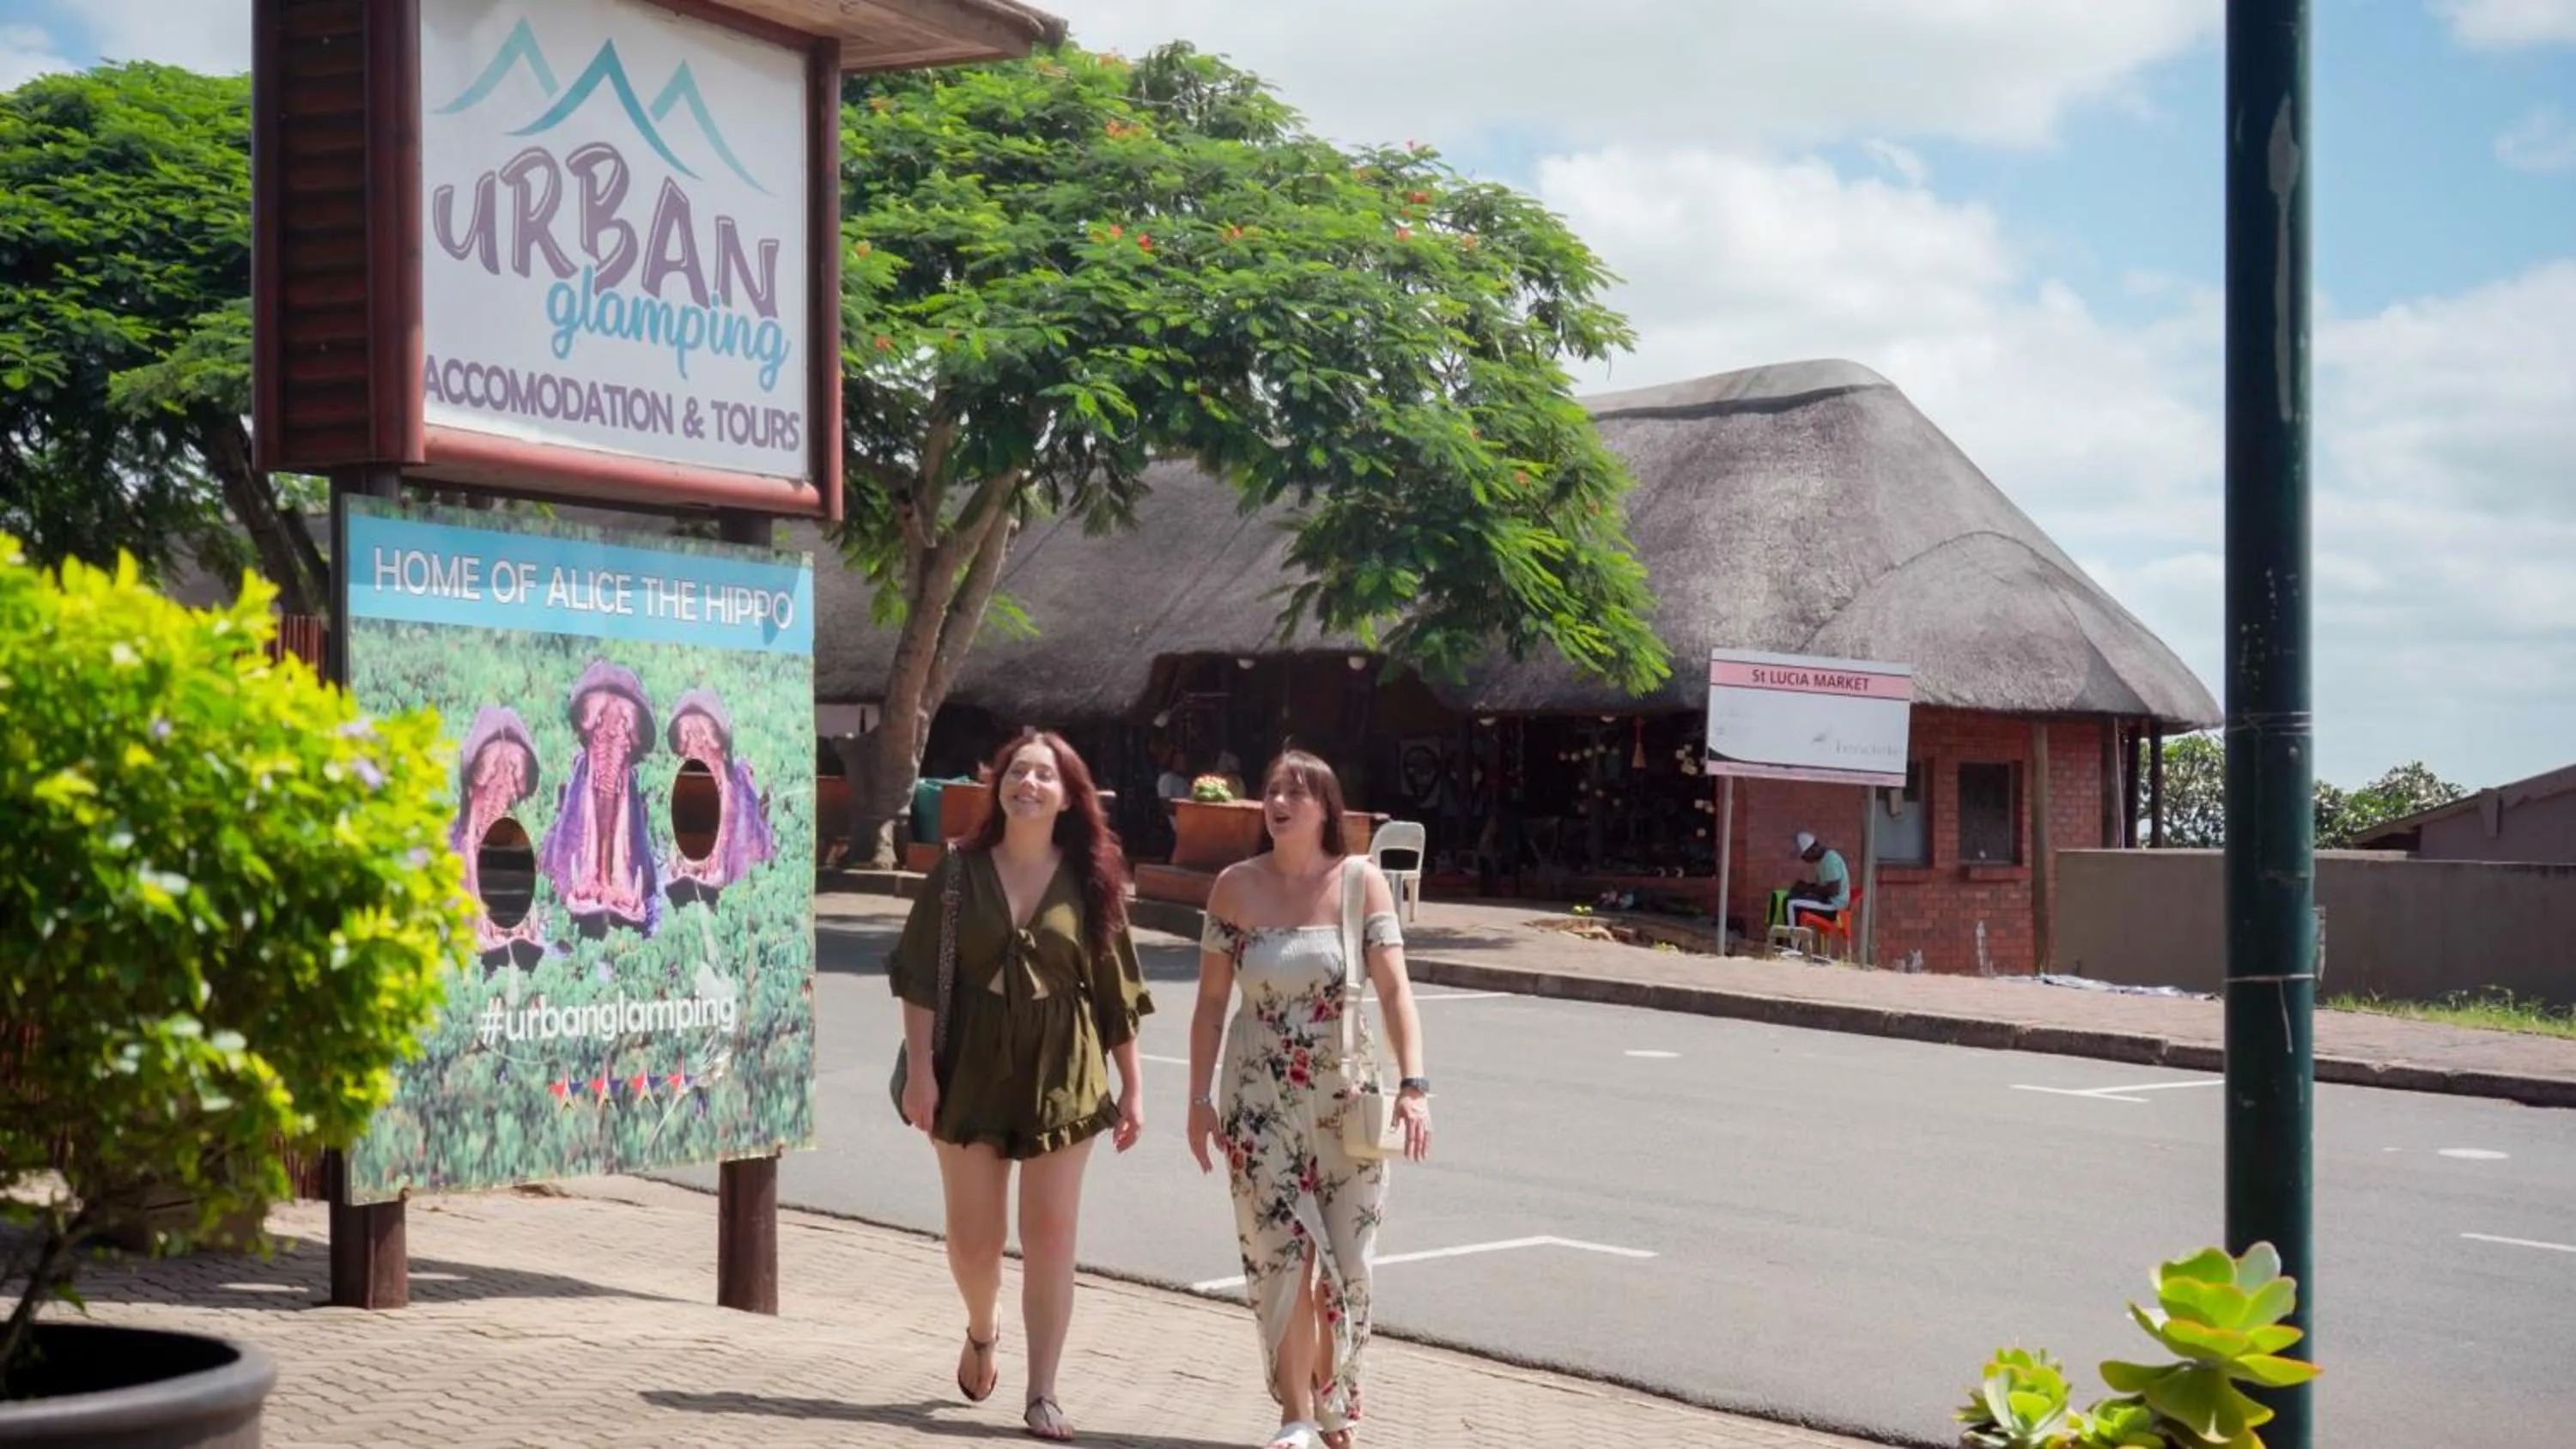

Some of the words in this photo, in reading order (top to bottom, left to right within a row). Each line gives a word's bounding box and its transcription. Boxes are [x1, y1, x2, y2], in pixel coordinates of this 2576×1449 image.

[432, 141, 780, 318] URBAN
[546, 264, 791, 393] glamping
[423, 354, 674, 434] ACCOMODATION
[682, 396, 705, 440] &
[710, 400, 799, 452] TOURS
[374, 547, 481, 601] HOME
[490, 561, 538, 603] OF
[545, 566, 634, 615] ALICE
[640, 576, 696, 621] THE
[704, 585, 794, 630] HIPPO
[1751, 669, 1766, 683] St
[1769, 670, 1809, 686] LUCIA
[1814, 674, 1869, 691] MARKET
[479, 990, 738, 1046] #urbanglamping
